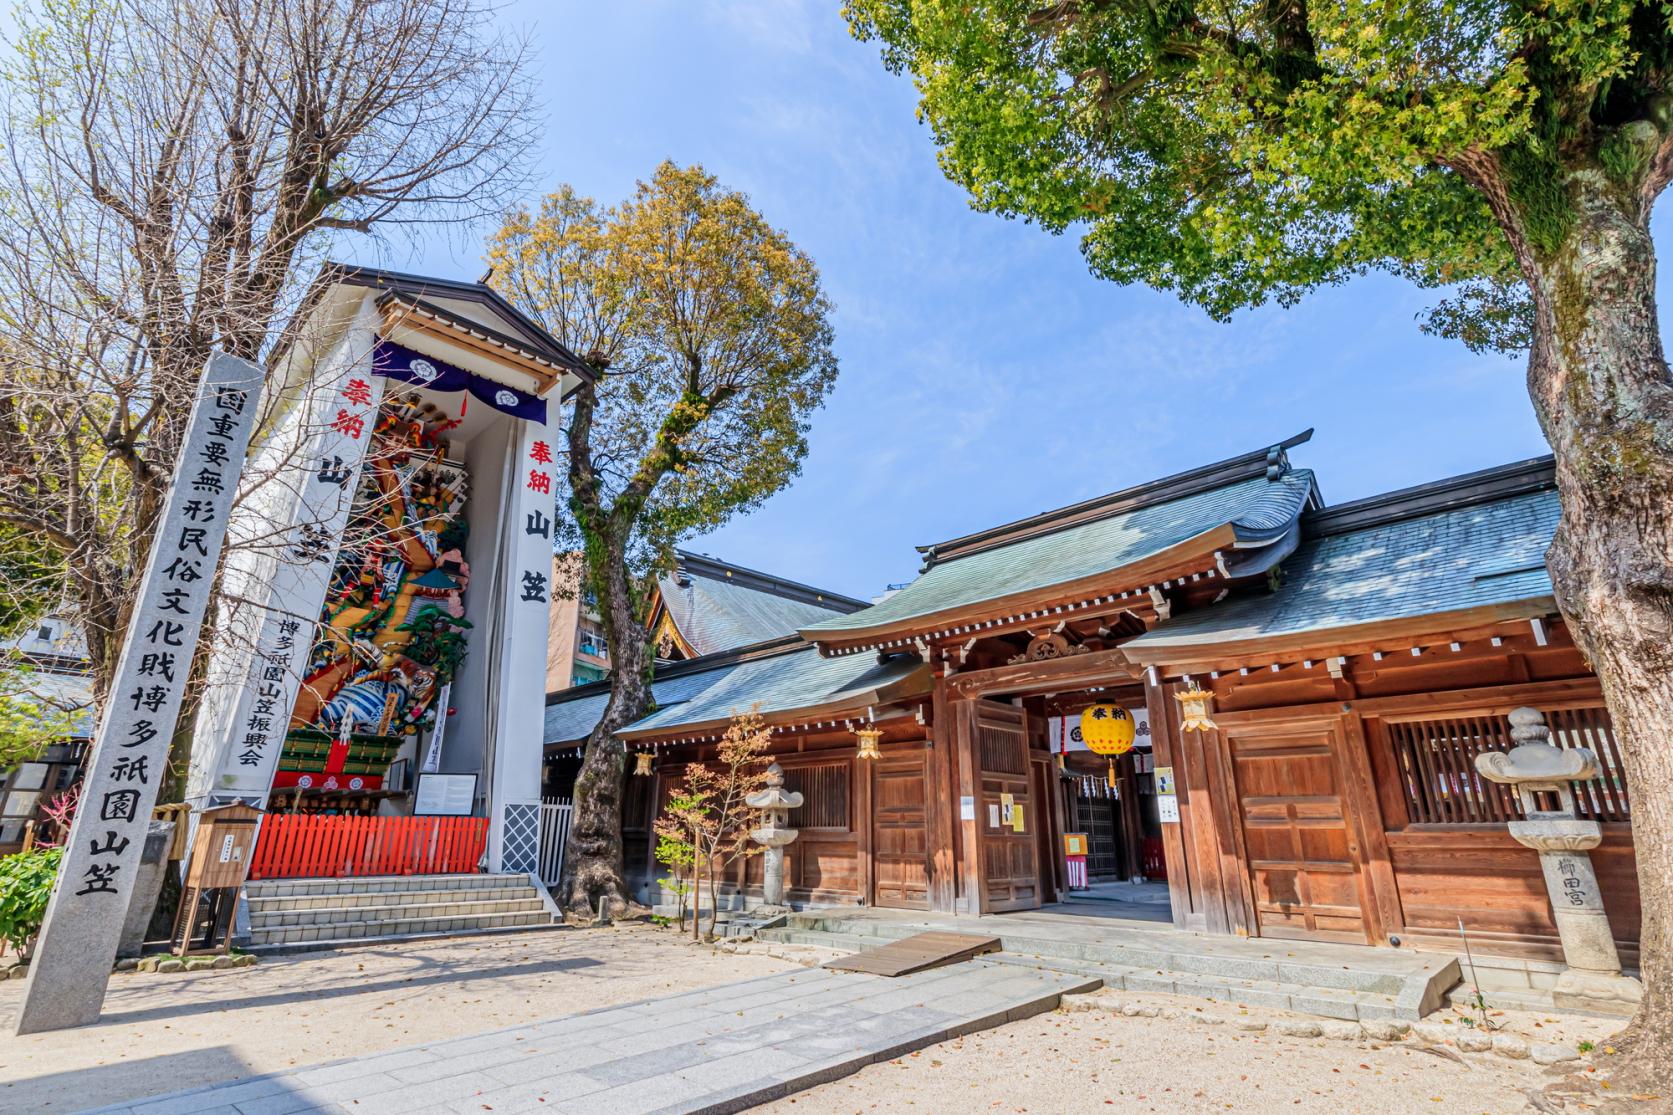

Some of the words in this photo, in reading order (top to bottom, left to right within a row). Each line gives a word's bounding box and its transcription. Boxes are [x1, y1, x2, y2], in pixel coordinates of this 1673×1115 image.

[331, 378, 372, 439] 奉納
[527, 440, 553, 495] 奉納
[293, 456, 353, 564] 山笠
[520, 509, 551, 603] 山笠
[1091, 707, 1127, 721] 奉納
